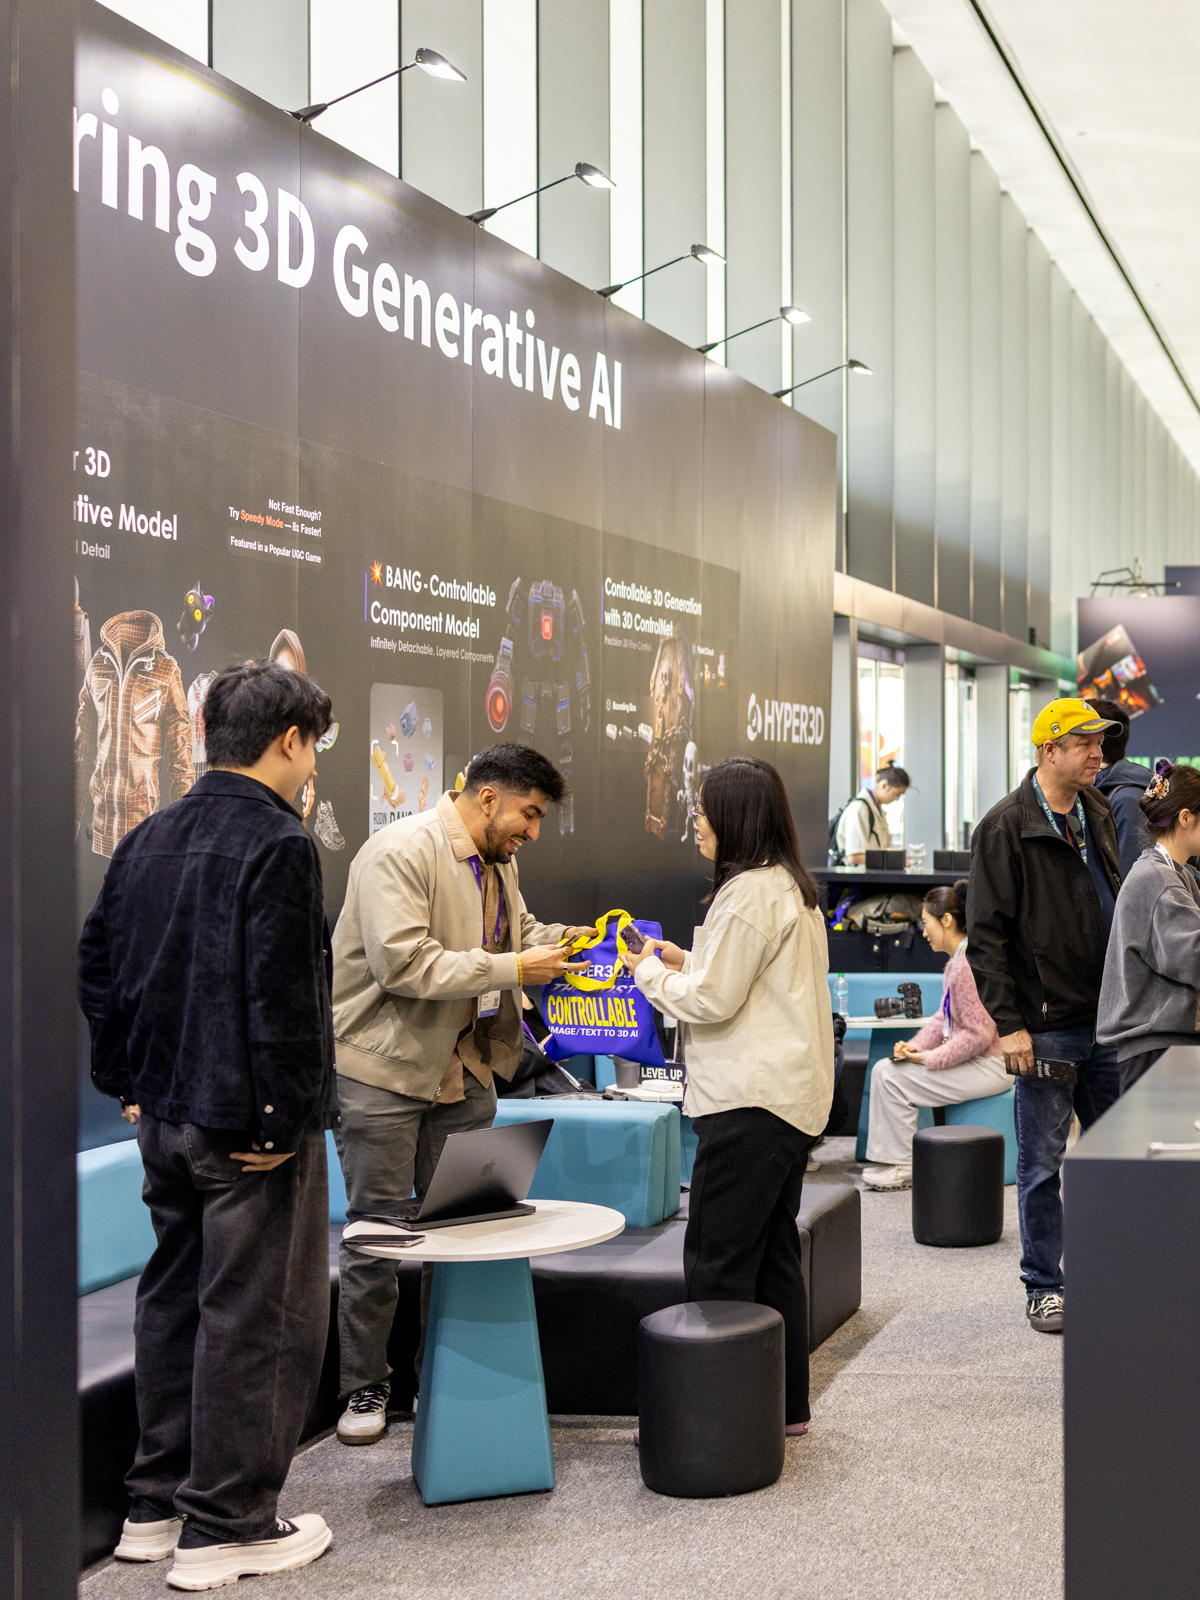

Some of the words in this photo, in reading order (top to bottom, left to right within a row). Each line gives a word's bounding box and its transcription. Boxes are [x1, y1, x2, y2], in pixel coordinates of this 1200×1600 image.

[234, 171, 316, 289] 3D
[332, 224, 582, 411] Generative
[588, 351, 622, 430] AI
[84, 446, 111, 478] 3D
[118, 503, 178, 541] Model
[229, 507, 240, 521] Try
[240, 509, 265, 526] Speedy
[265, 515, 284, 529] Mode
[292, 522, 300, 533] 8x
[300, 524, 322, 538] Faster!
[268, 499, 281, 511] Not
[281, 502, 295, 515] Fast
[295, 506, 322, 521] Enough?
[81, 540, 111, 559] Detail
[230, 536, 257, 551] Featured
[257, 541, 264, 552] in
[263, 545, 269, 553] a
[269, 544, 291, 557] Popular
[291, 548, 305, 560] UGC
[305, 551, 322, 564] Game
[385, 565, 422, 593] BANG
[429, 574, 497, 607] Controllable
[604, 577, 652, 605] Controllable
[652, 588, 664, 607] 3D
[664, 591, 702, 616] Generation
[370, 600, 443, 633] Component
[444, 613, 480, 639] Model
[604, 608, 621, 628] with
[621, 610, 633, 630] 3D
[633, 613, 674, 637] ControlNet
[370, 636, 398, 653] Infinitely
[398, 639, 435, 656] Detachable,
[436, 645, 460, 660] Layered
[460, 648, 495, 664] Components
[612, 701, 630, 713] Bounding
[629, 702, 637, 712] Box
[764, 699, 825, 745] HYPER3D
[547, 995, 638, 1028] CONTROLLABLE
[603, 1028, 616, 1037] TO
[617, 1029, 629, 1038] 3D
[629, 1029, 639, 1038] AI
[641, 1066, 669, 1080] LEVEL
[669, 1068, 683, 1081] UP
